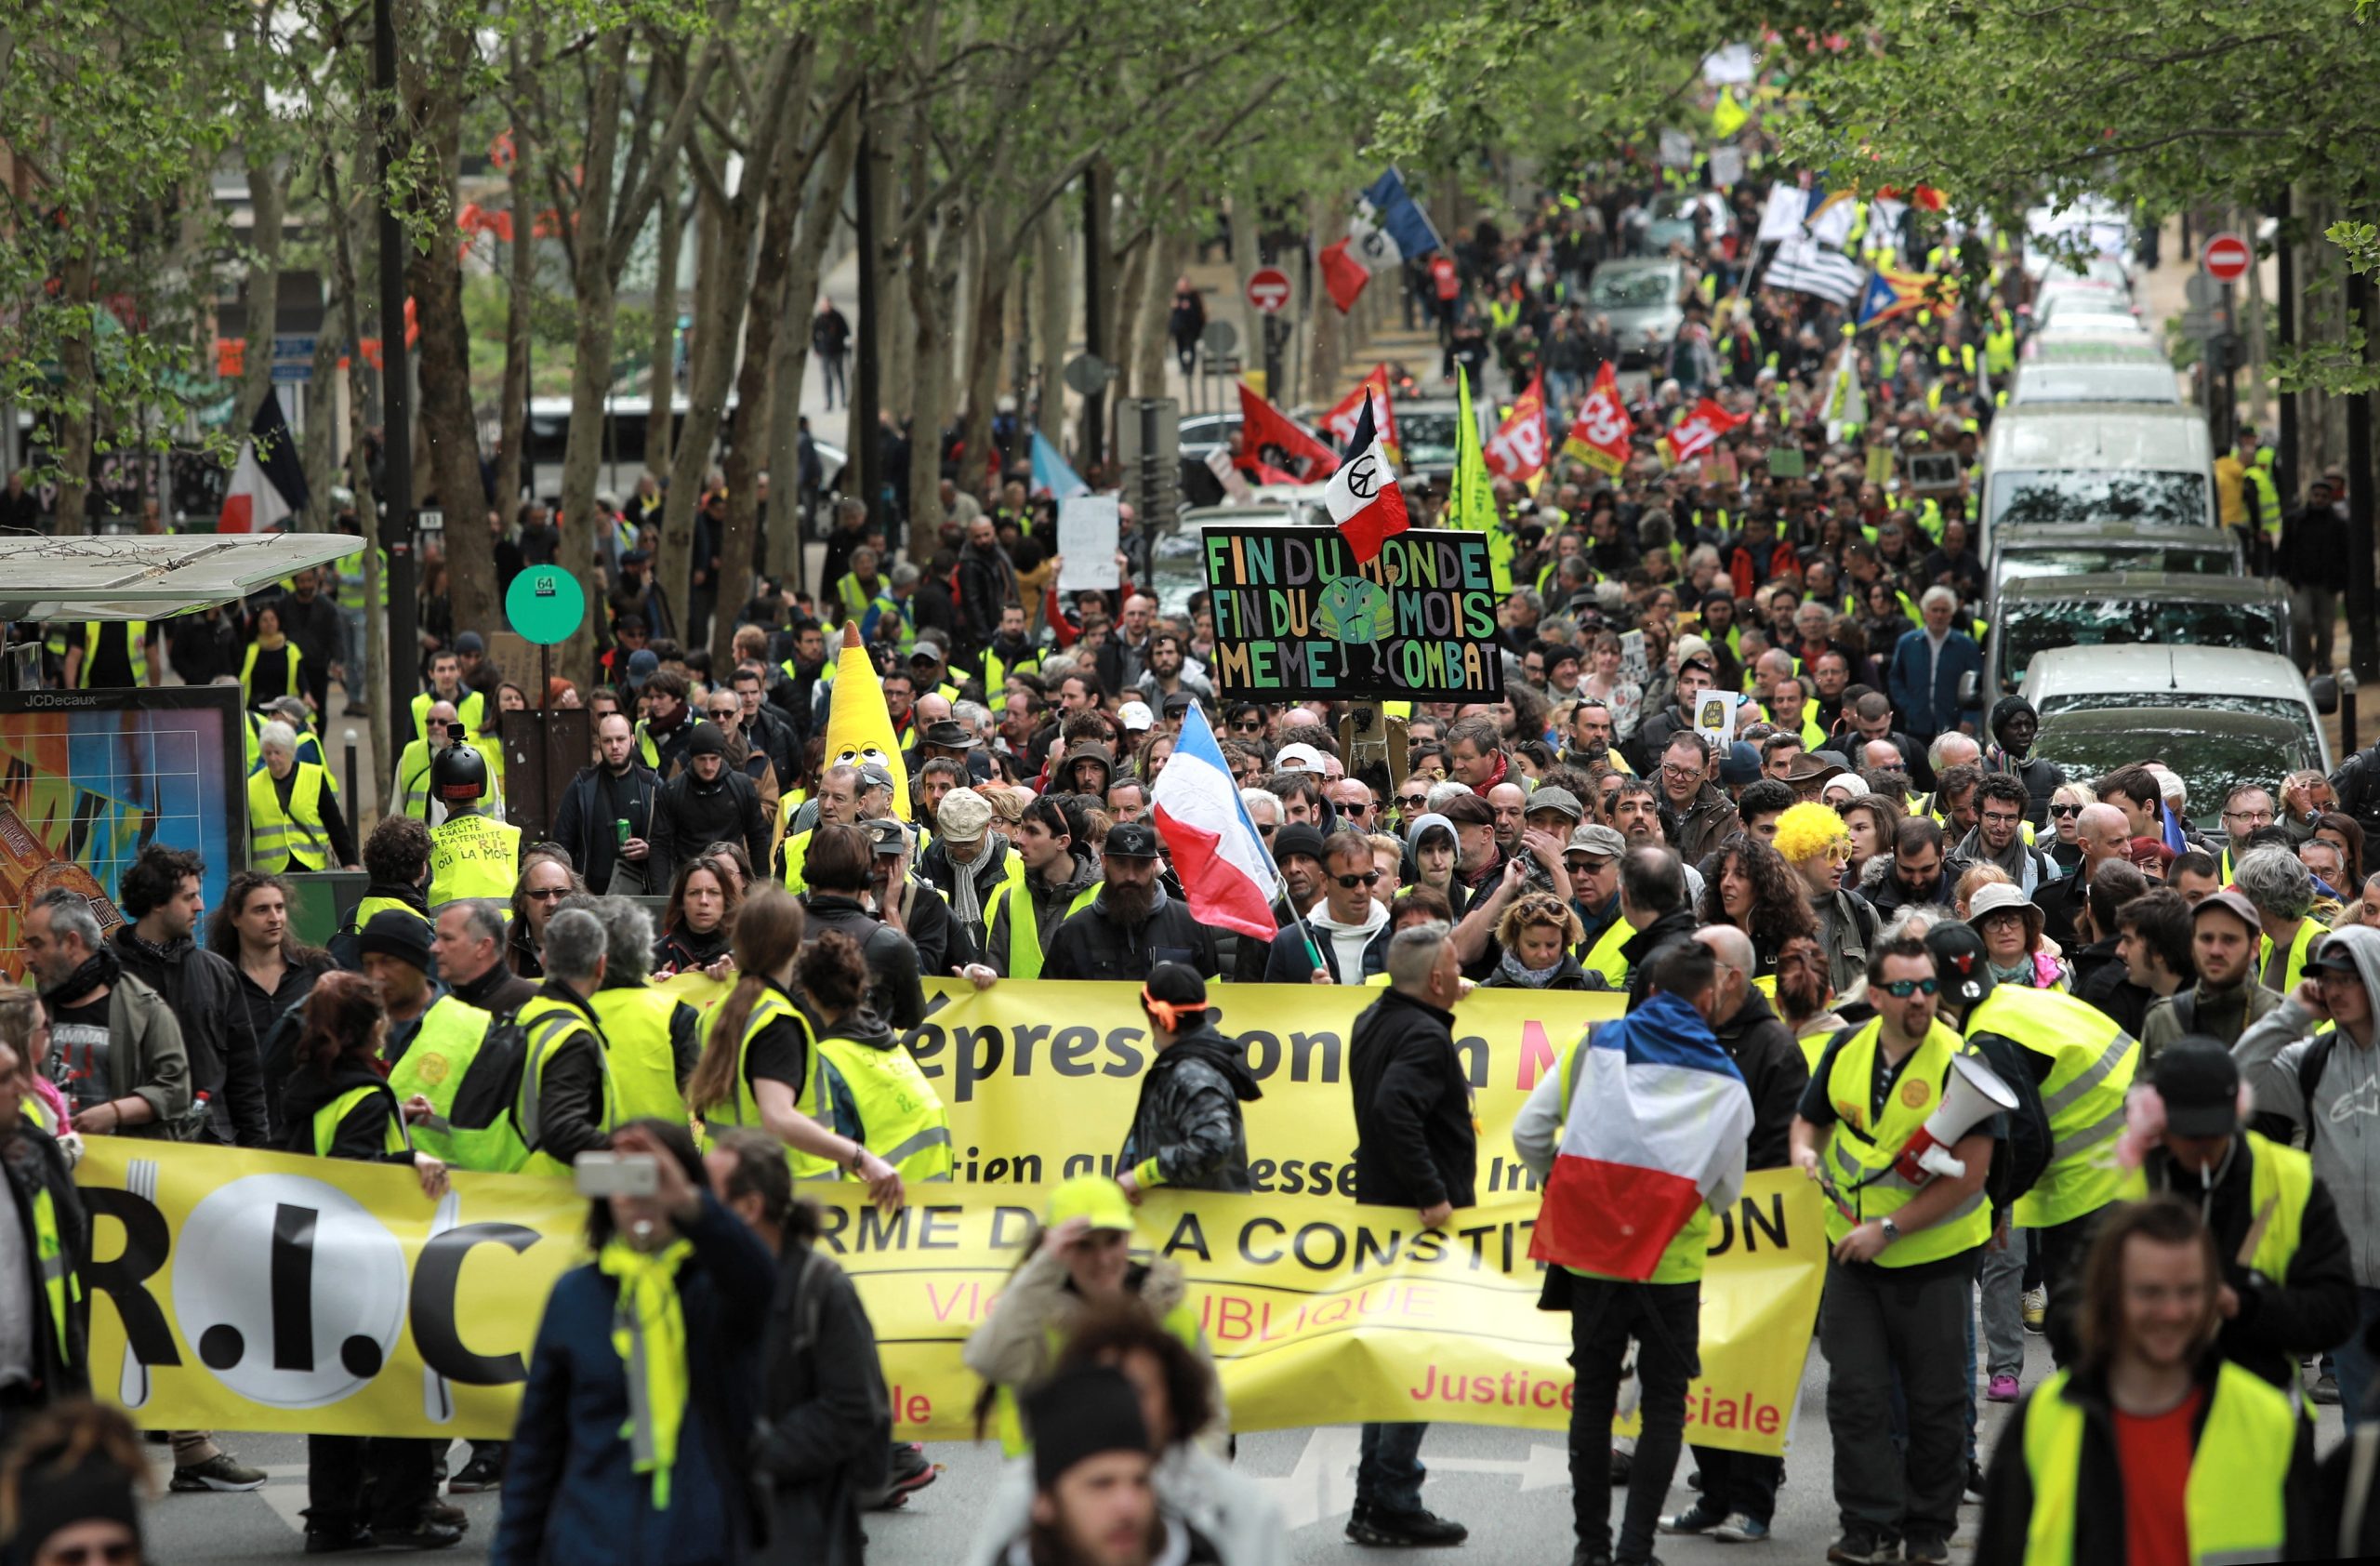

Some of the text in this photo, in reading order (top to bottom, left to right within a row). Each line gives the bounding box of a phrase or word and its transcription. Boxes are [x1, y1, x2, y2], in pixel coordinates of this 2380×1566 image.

[537, 577, 553, 590] 64
[1207, 536, 1276, 585] FIN
[1284, 537, 1341, 585] DU
[1212, 589, 1495, 639] FIN DU MOIS
[1386, 639, 1496, 691] COMBAT
[24, 695, 97, 708] JCDecaux
[438, 855, 453, 869] OU
[461, 849, 477, 860] LA
[1237, 1193, 1790, 1274] CONSTION
[1200, 1286, 1439, 1342] BLIQUE
